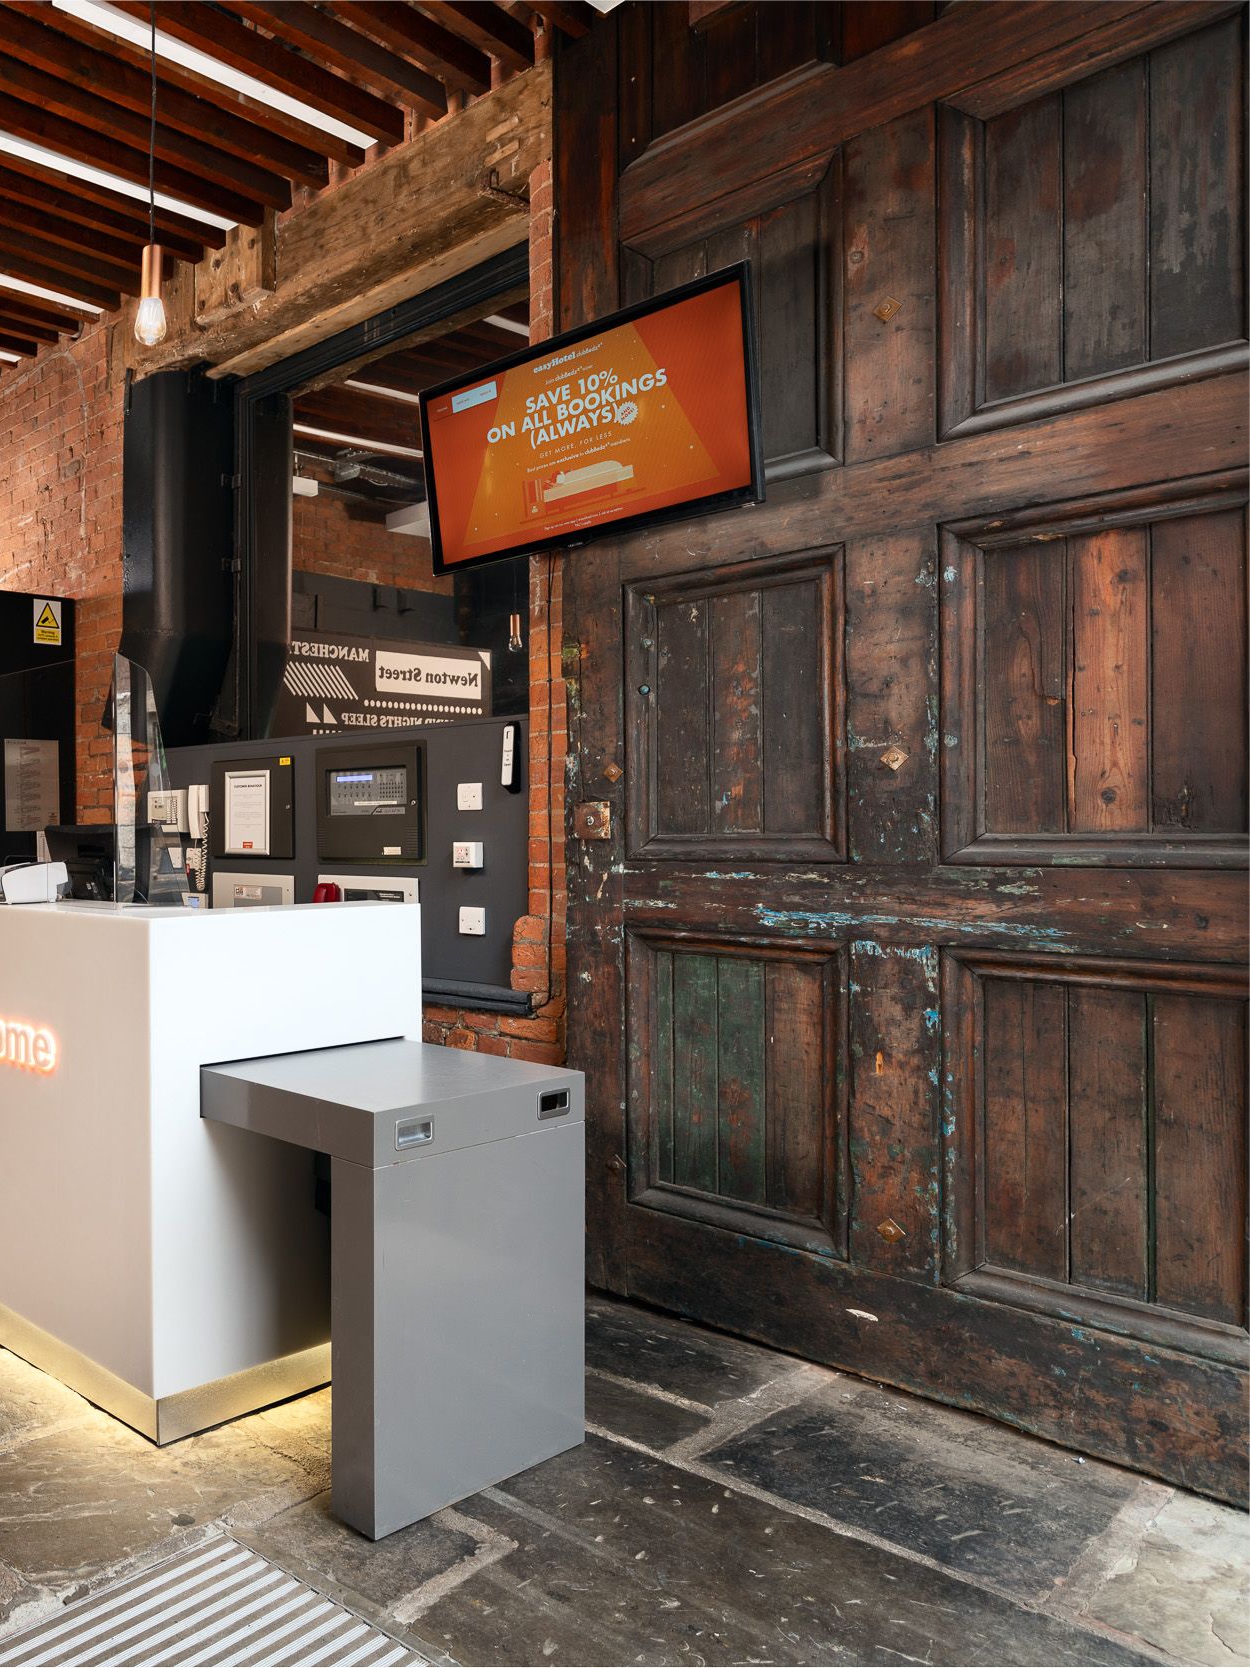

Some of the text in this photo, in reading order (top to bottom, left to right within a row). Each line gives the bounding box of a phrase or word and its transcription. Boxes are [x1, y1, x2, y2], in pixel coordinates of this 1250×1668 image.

[533, 351, 576, 373] easyHotel
[487, 368, 667, 444] ON ALL BOOKINGS
[525, 368, 618, 413] SAVE 10%
[530, 402, 618, 449] (ALWAYS)
[620, 406, 631, 416] AND
[539, 449, 552, 458] GET
[580, 437, 593, 445] FOR
